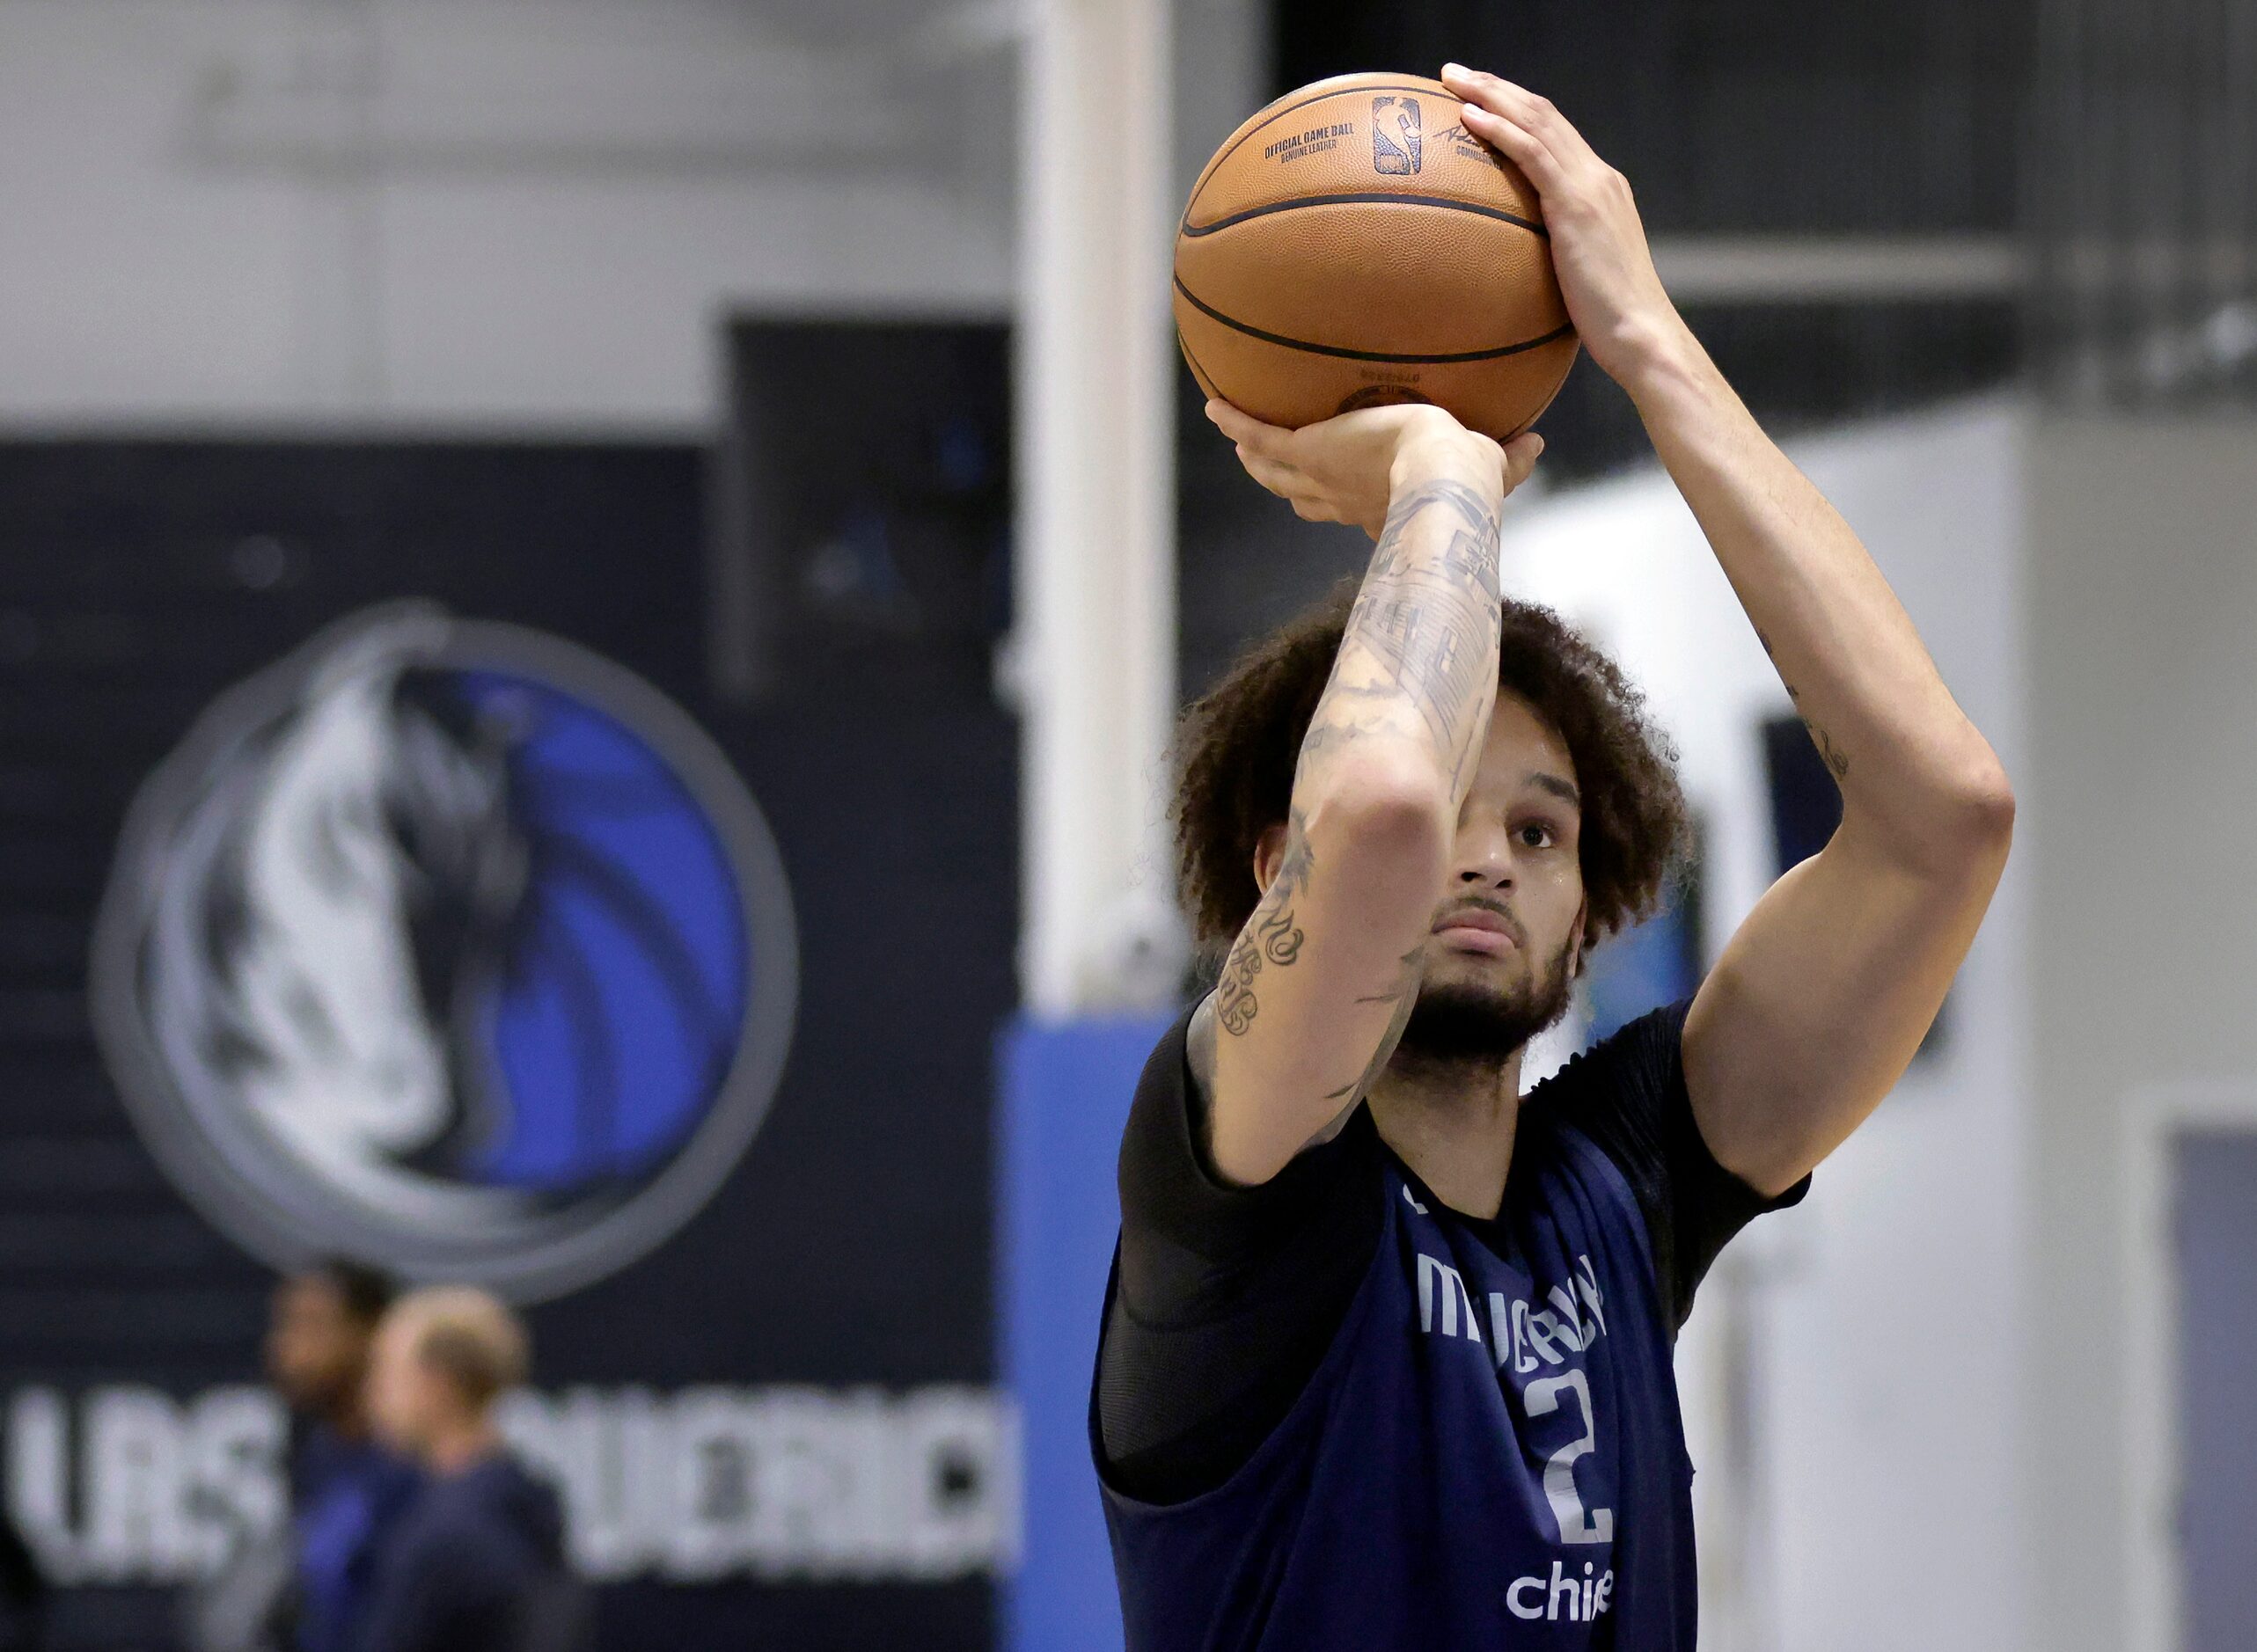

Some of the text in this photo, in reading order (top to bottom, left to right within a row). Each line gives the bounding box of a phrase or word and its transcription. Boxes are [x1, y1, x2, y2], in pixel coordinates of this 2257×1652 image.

[1264, 122, 1354, 159] OFFICIAL GAME BALL
[1280, 139, 1337, 164] GENUINE LEATHER
[1524, 1369, 1614, 1545] 2
